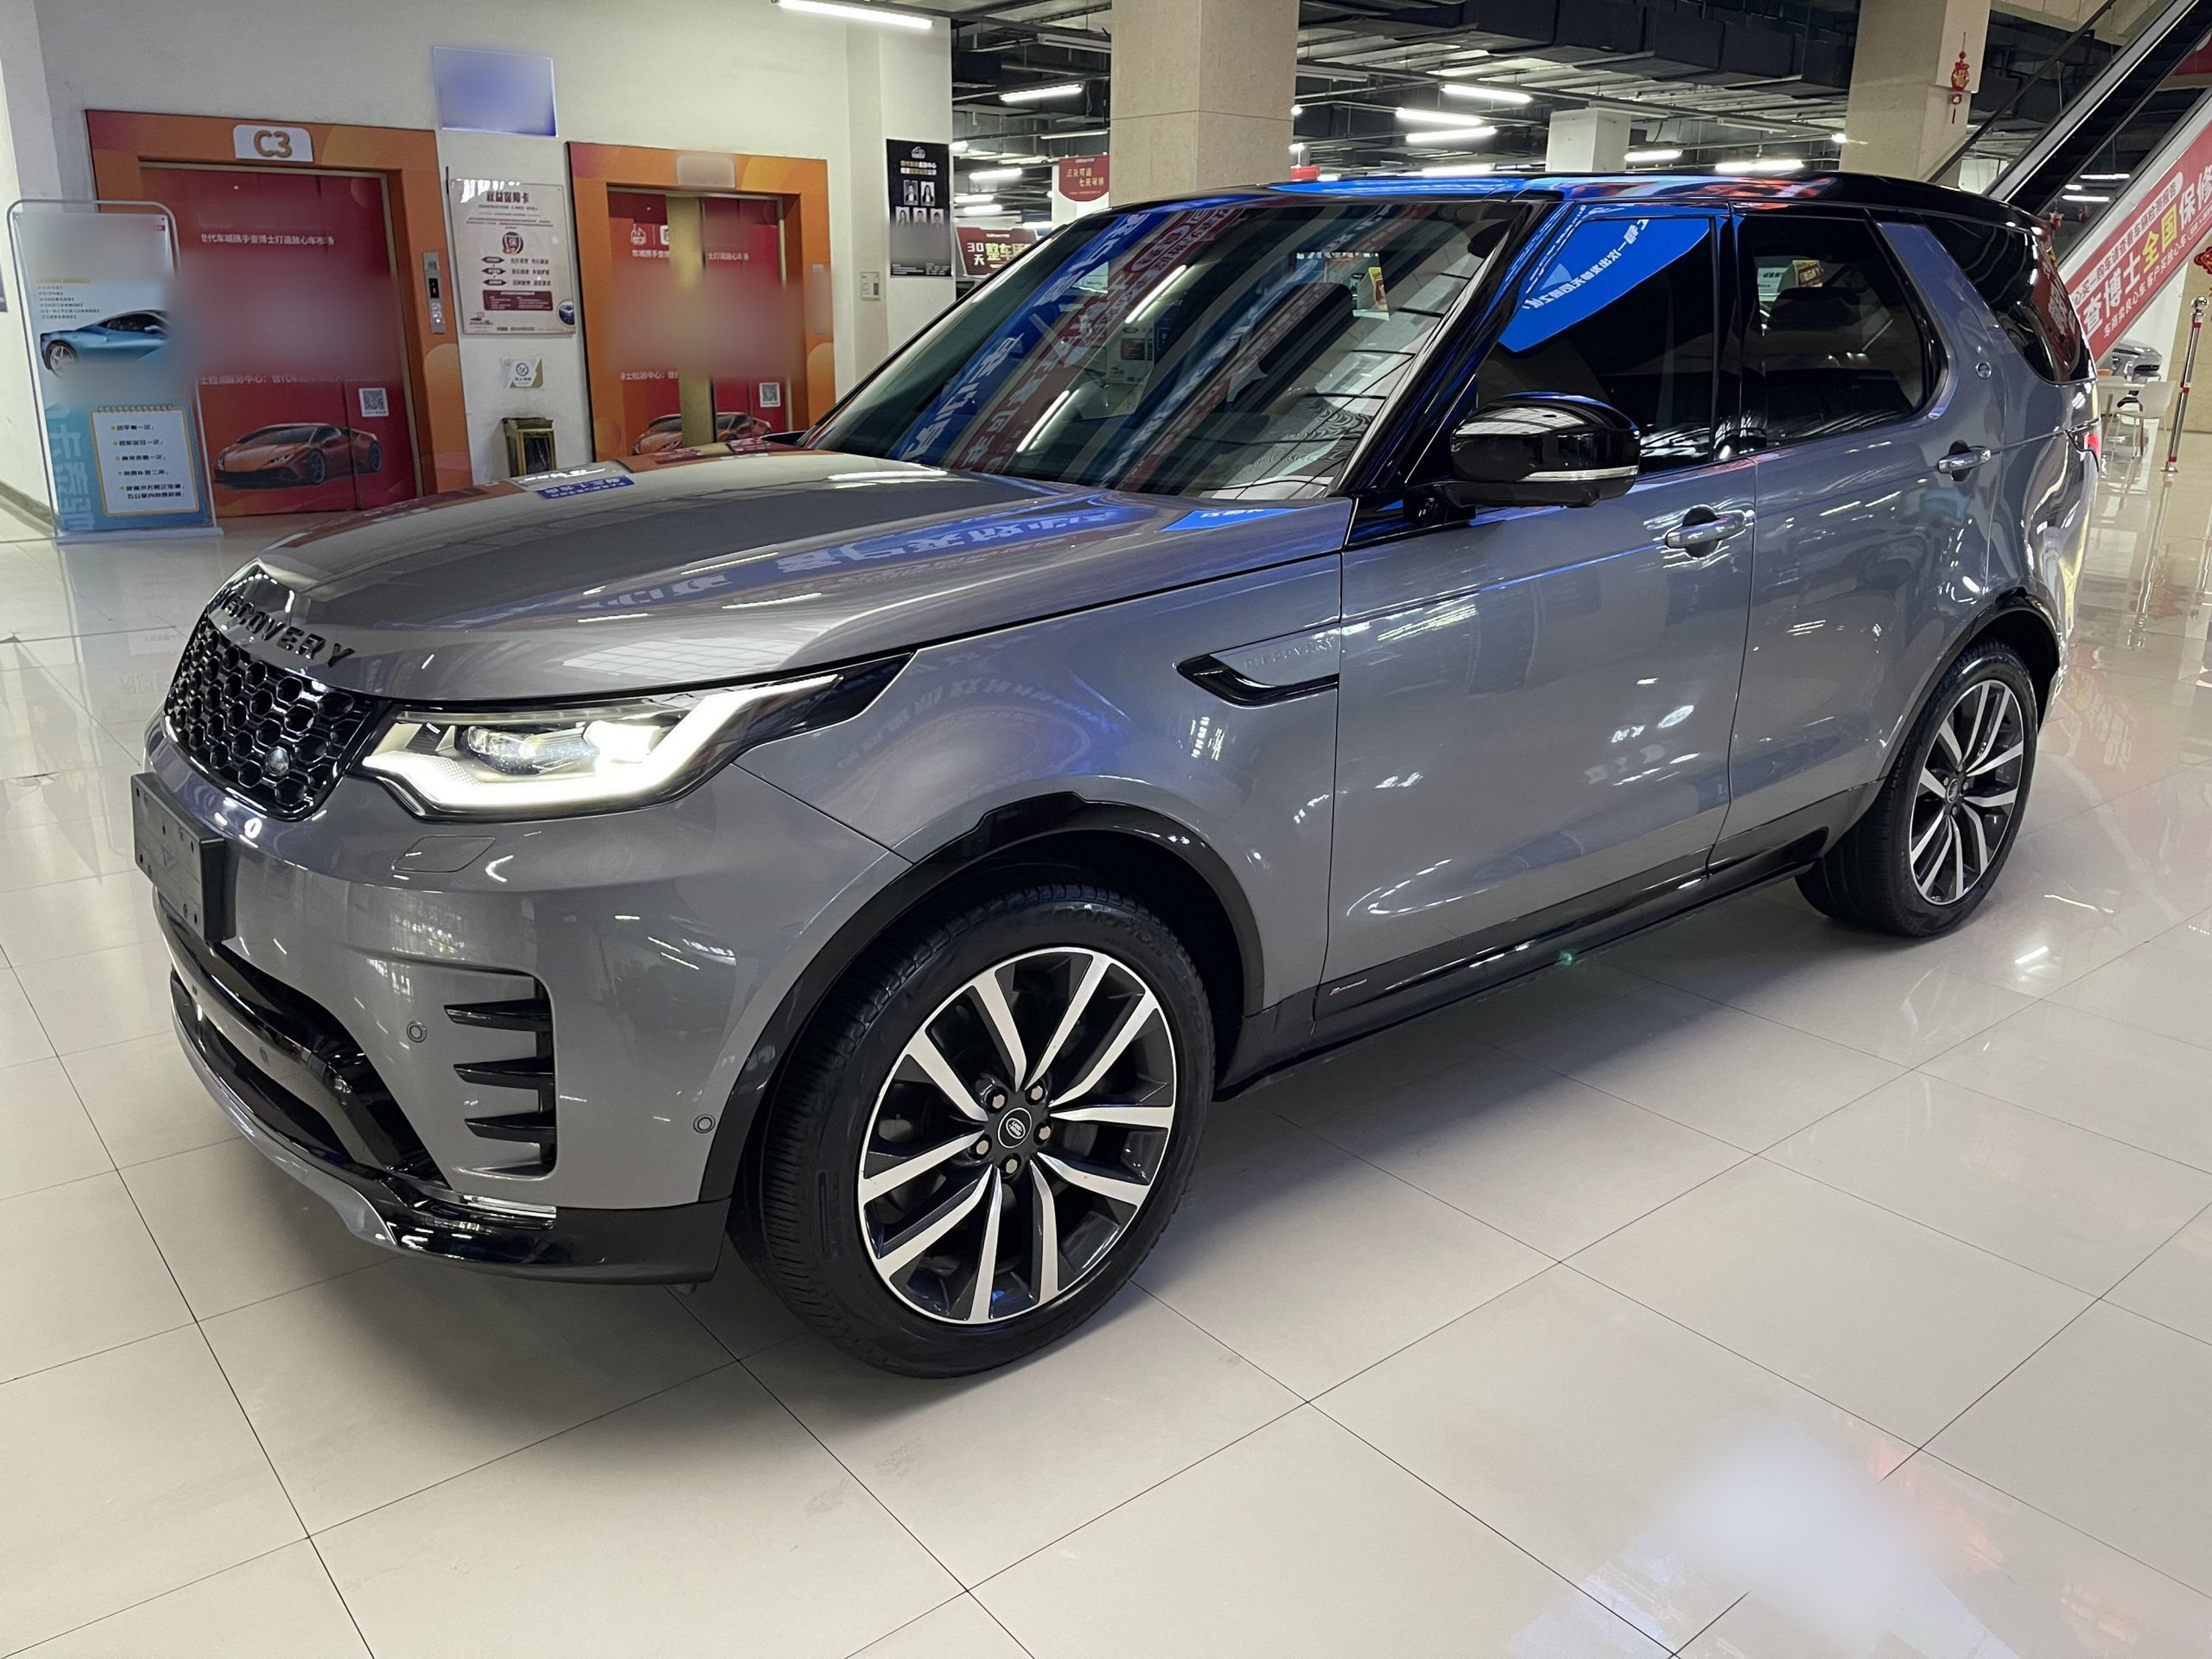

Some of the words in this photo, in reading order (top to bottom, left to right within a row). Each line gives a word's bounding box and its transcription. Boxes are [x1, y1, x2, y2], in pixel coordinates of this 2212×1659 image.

[253, 130, 292, 158] C3
[967, 243, 984, 252] 30
[974, 254, 986, 266] 天
